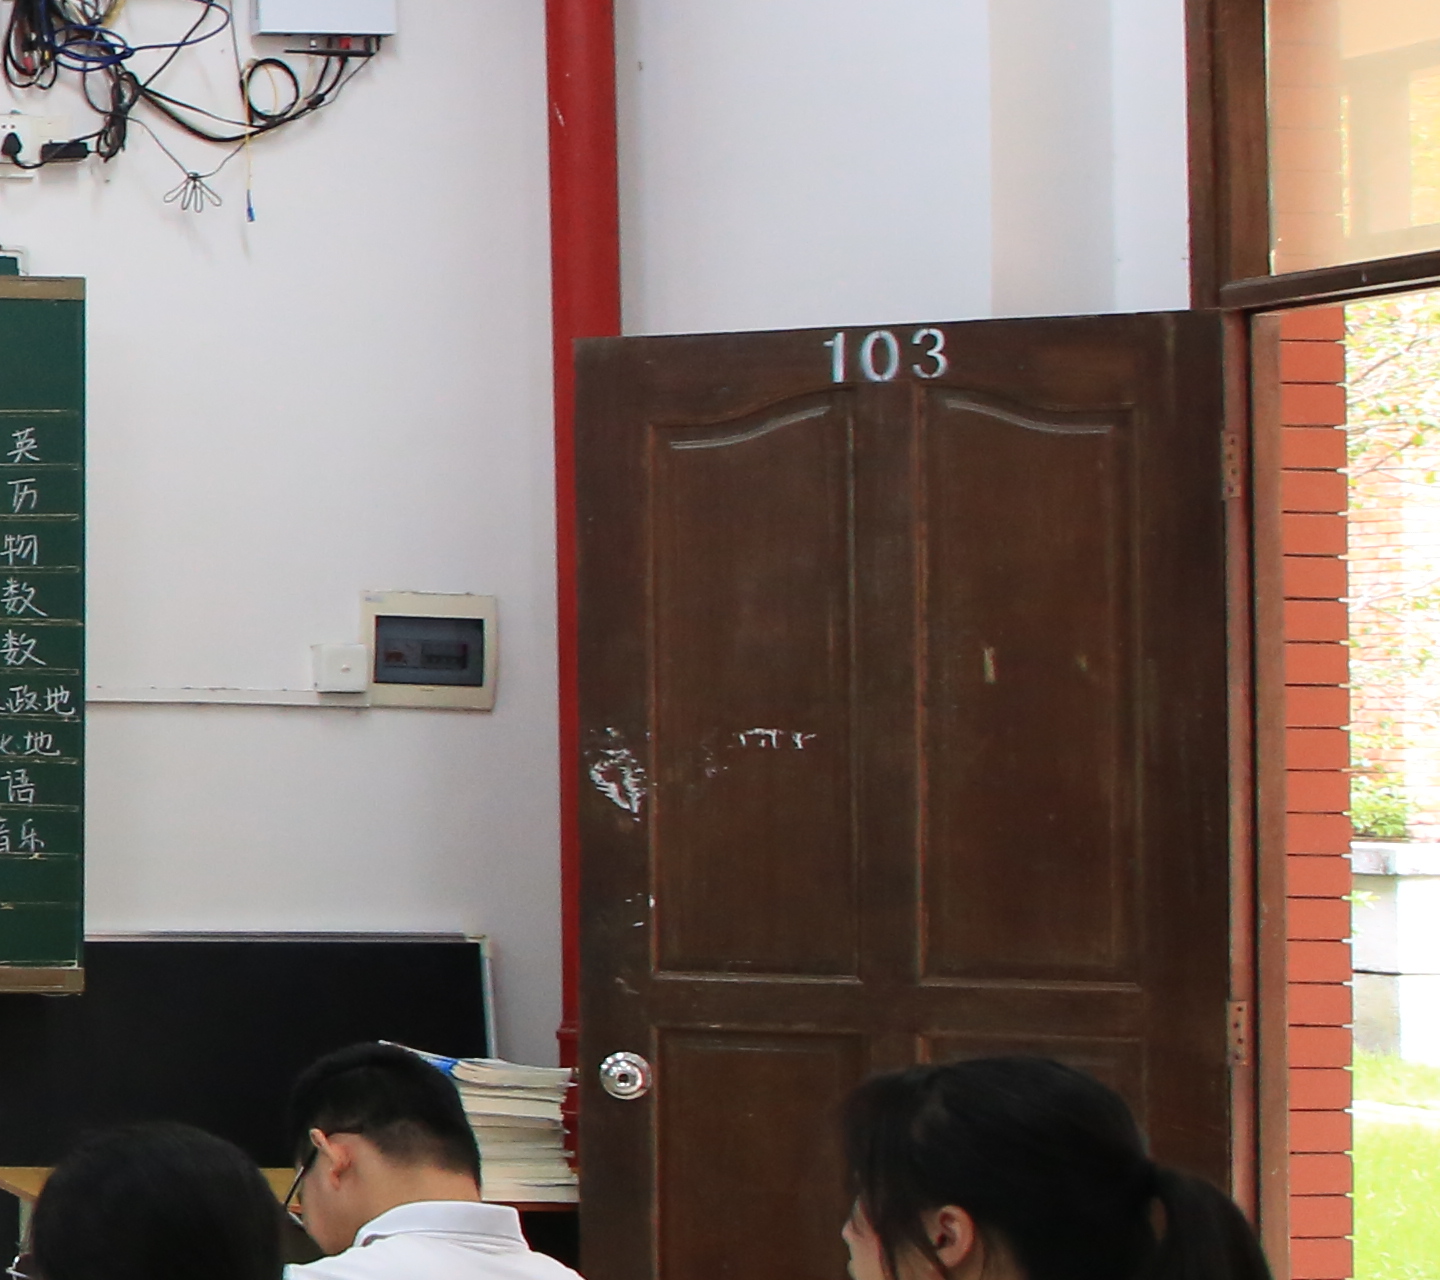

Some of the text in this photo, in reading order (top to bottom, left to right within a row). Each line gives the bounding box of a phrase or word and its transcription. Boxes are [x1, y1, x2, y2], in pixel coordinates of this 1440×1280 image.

[823, 328, 948, 383] 103
[6, 427, 41, 463] 英
[6, 477, 38, 513] 历
[0, 533, 39, 567] 物
[0, 577, 48, 617] 数
[1, 768, 37, 805] 语
